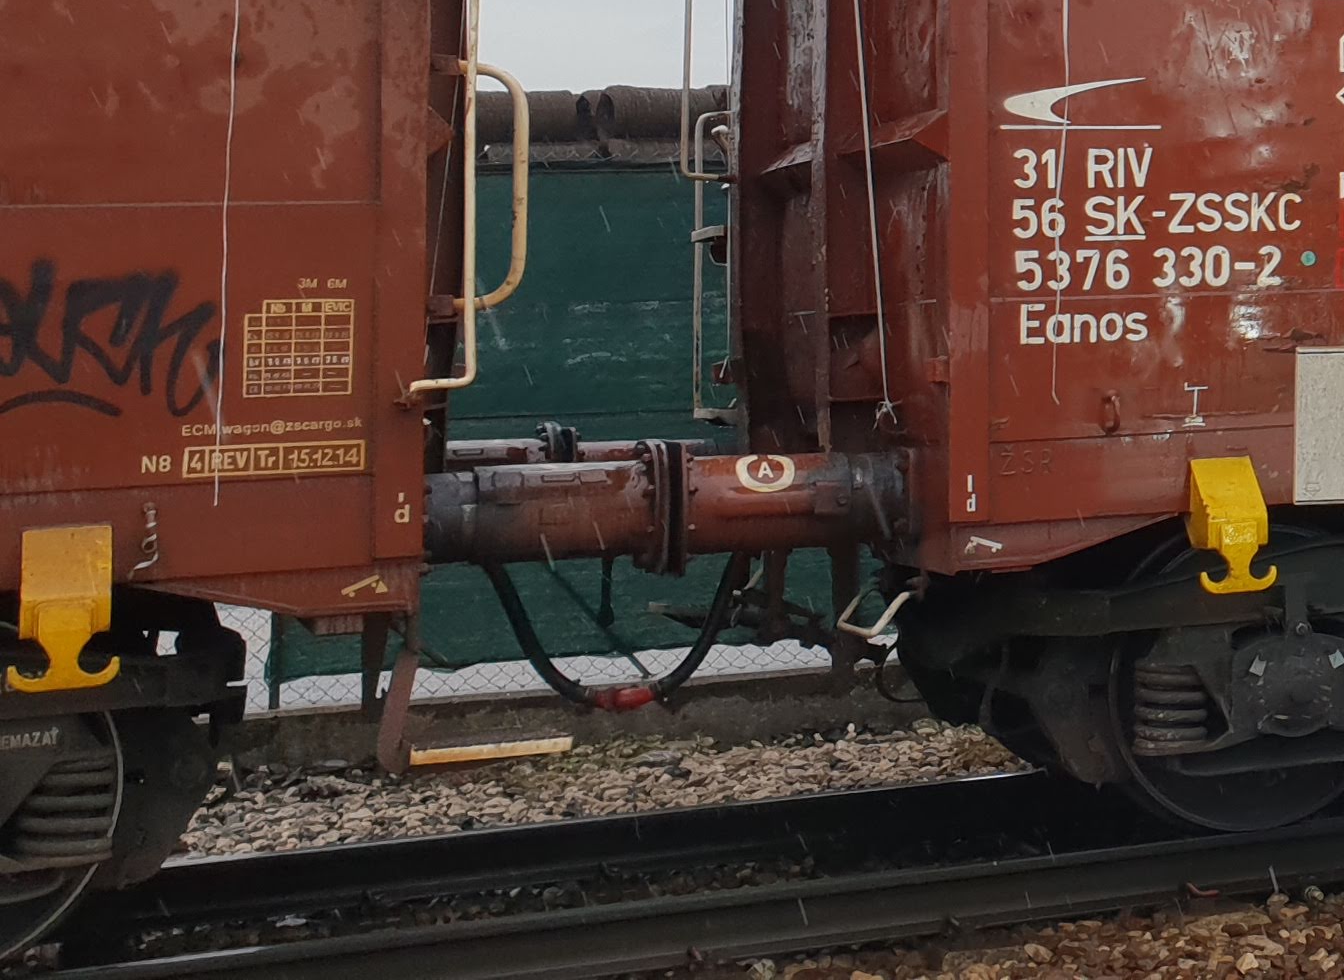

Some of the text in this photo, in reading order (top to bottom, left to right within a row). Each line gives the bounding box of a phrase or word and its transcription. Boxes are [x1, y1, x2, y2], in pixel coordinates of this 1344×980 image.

[1013, 146, 1152, 189] 31 RIV
[1012, 198, 1066, 239] 56
[1015, 245, 1282, 291] 5376 330-2
[1020, 303, 1149, 345] Eanos
[141, 455, 172, 473] N8
[189, 454, 202, 472] 4
[211, 451, 248, 470] REV
[256, 450, 277, 467] Tr
[757, 461, 774, 478] A
